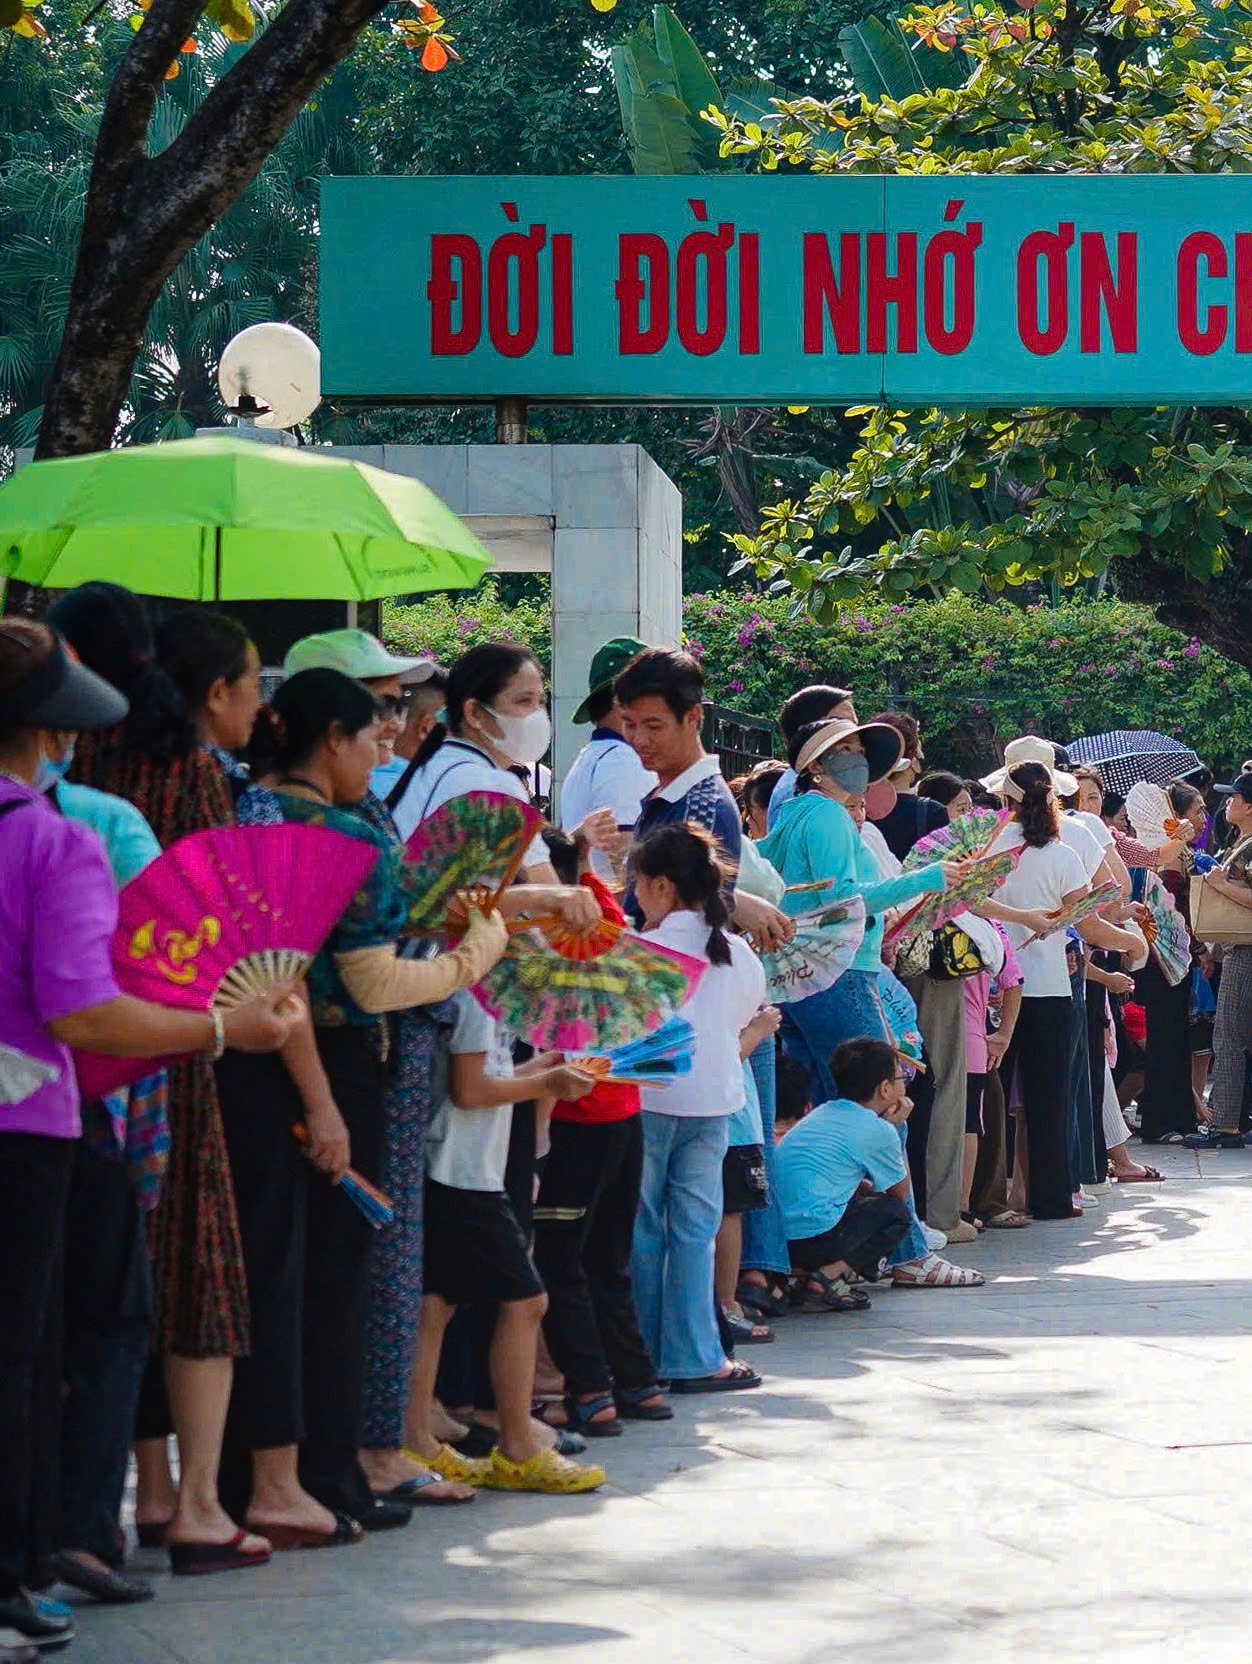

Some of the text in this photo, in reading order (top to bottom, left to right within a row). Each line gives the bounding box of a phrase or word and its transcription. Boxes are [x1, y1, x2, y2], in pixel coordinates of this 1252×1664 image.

[427, 201, 571, 356] ĐỜI
[615, 198, 759, 356] ĐỜI
[803, 199, 983, 356] NHỚ
[1017, 221, 1138, 356] ƠN
